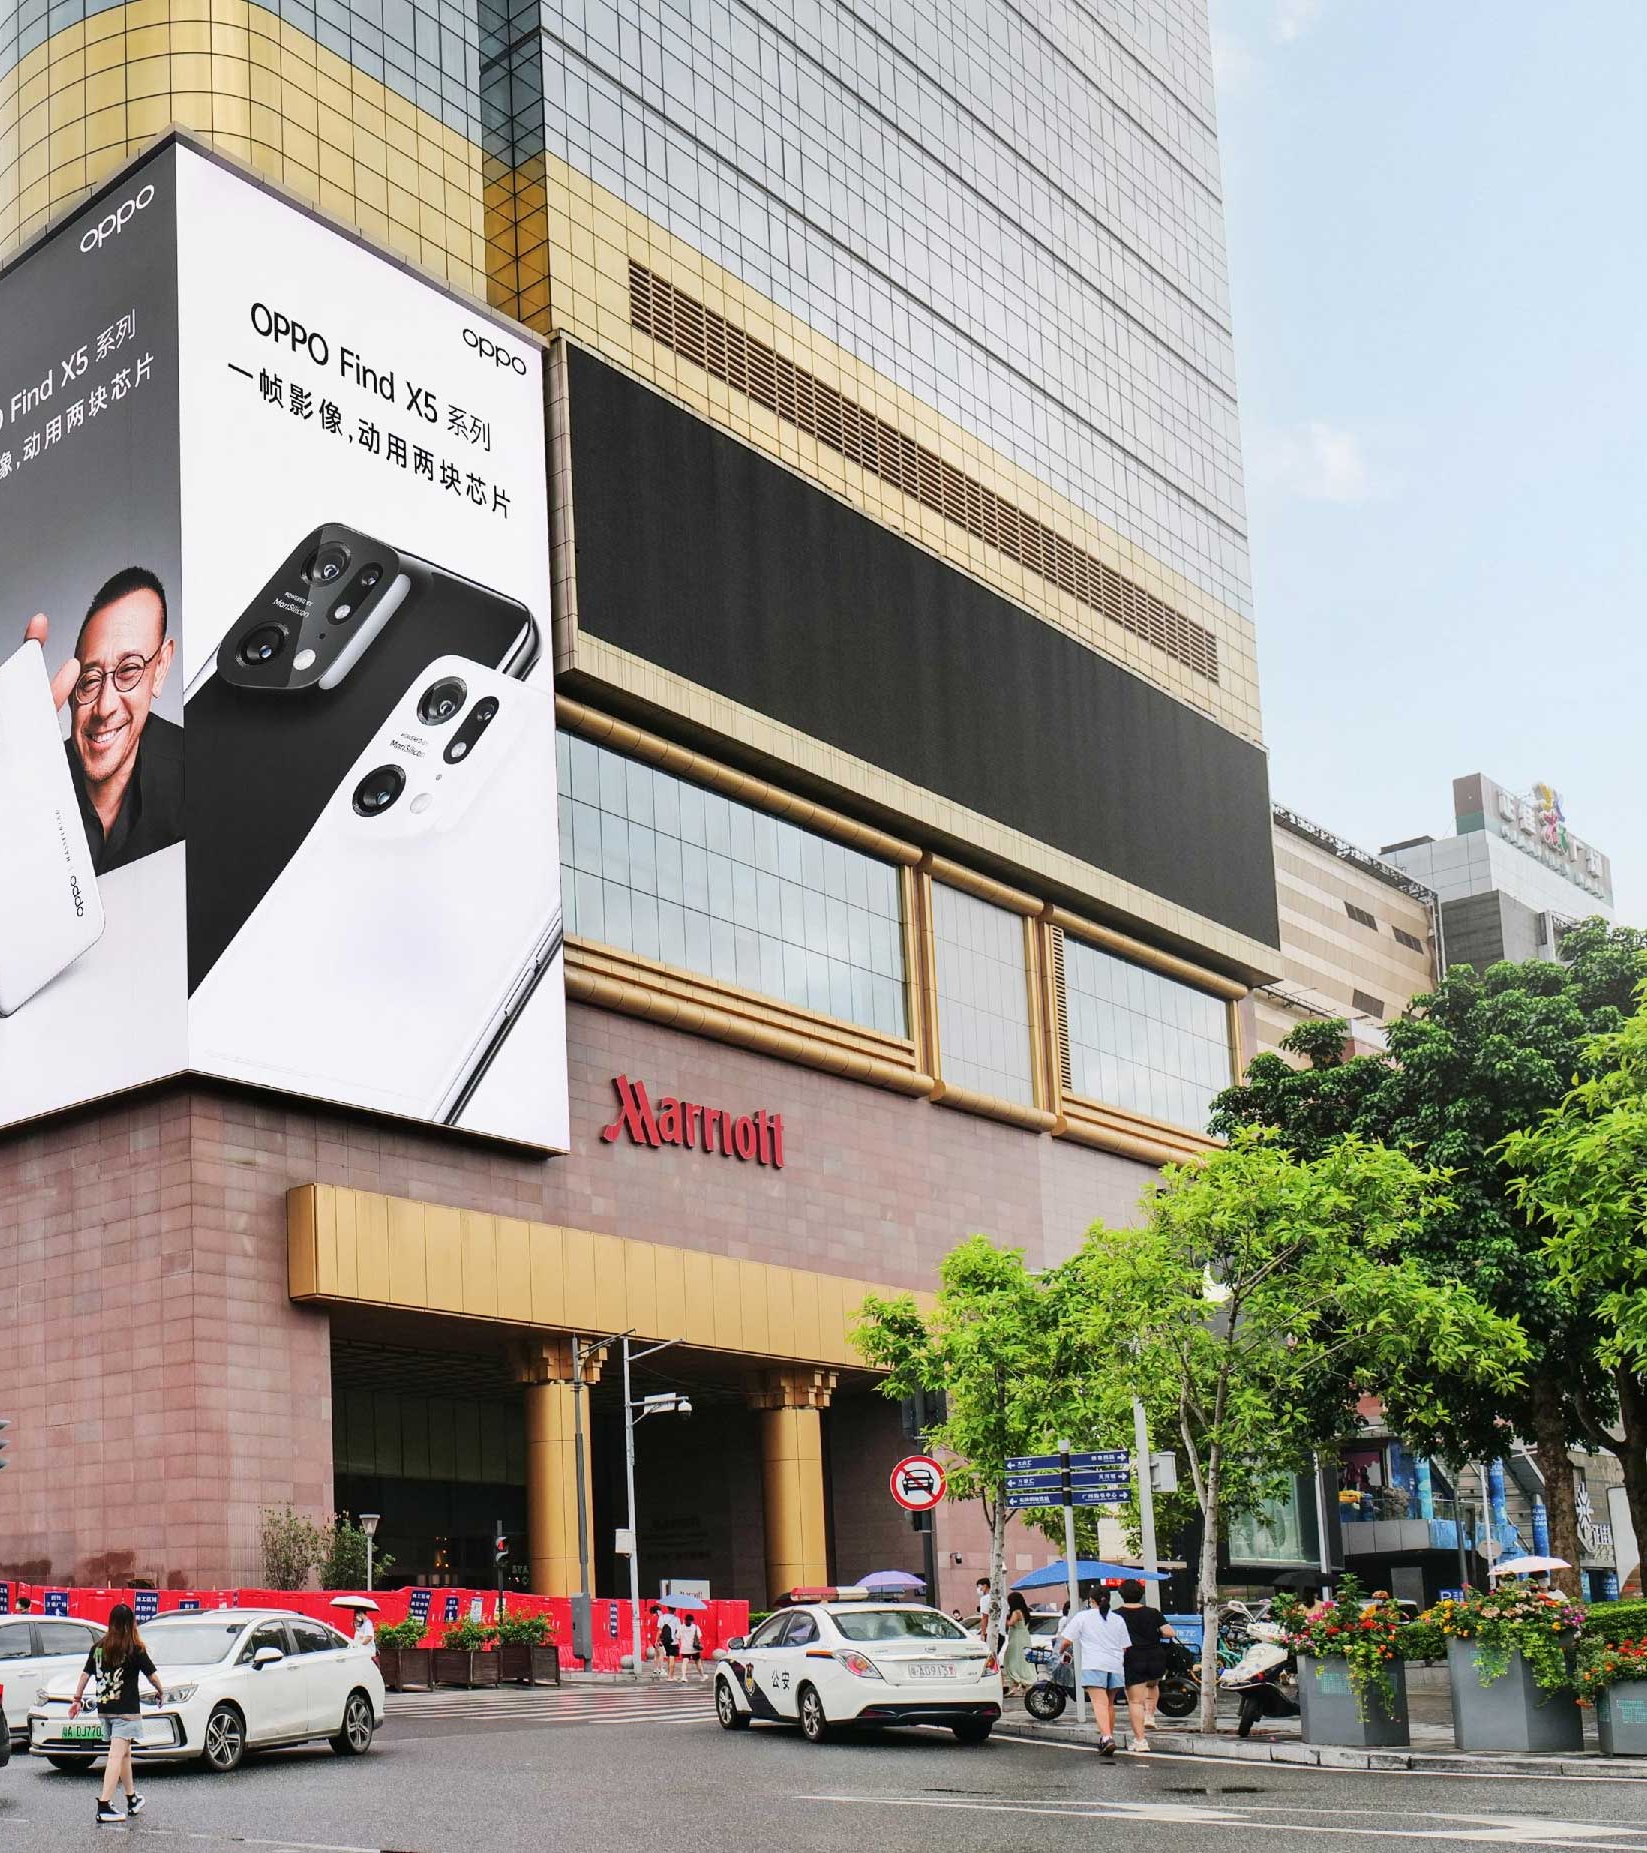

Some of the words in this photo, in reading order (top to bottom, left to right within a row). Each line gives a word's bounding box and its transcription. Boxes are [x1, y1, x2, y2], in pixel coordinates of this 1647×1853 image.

[79, 184, 155, 252] oppo
[10, 370, 53, 423] Find
[61, 346, 89, 387] X5
[95, 309, 136, 362] 系列
[250, 302, 329, 366] OPPO
[340, 346, 394, 402] Find
[406, 381, 438, 424] X5
[448, 404, 491, 452] 系列
[462, 328, 527, 376] oppo
[600, 1074, 785, 1169] Marriott
[771, 1668, 790, 1691] 公安
